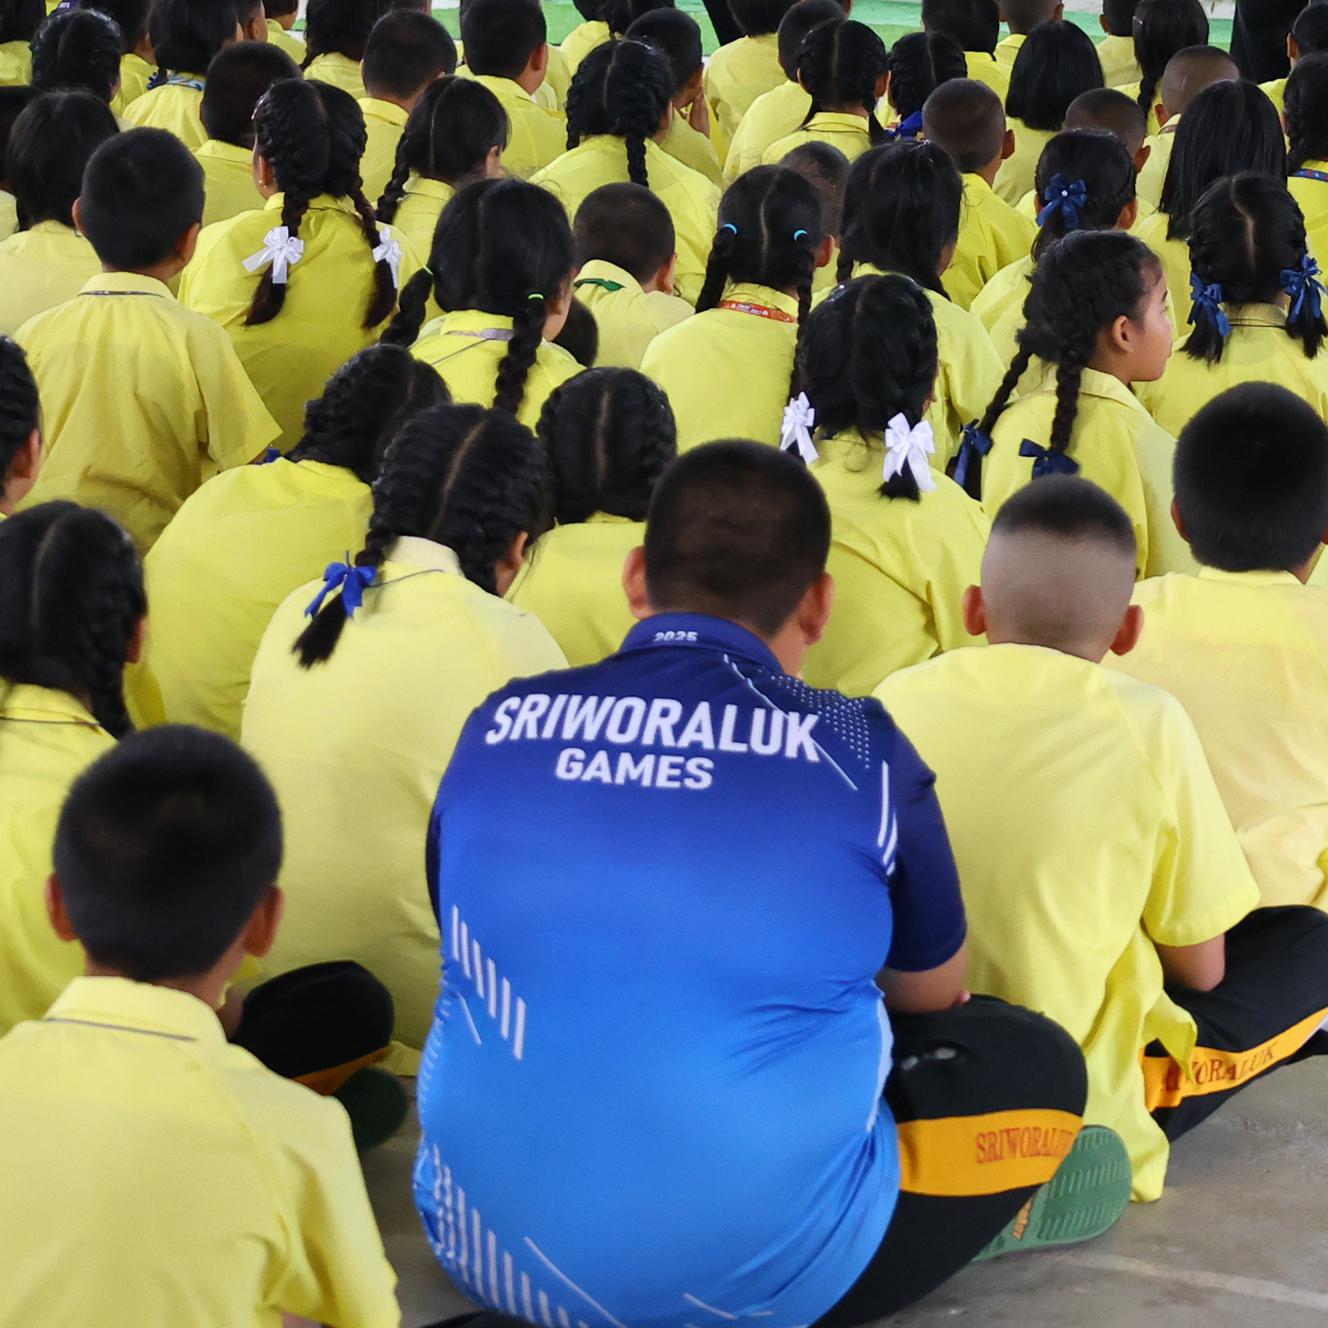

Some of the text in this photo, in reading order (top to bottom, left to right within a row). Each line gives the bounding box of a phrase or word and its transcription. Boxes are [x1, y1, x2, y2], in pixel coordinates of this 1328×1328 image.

[652, 630, 699, 643] 2025
[484, 692, 821, 763] SRIWORALUK
[554, 746, 715, 790] GAMES
